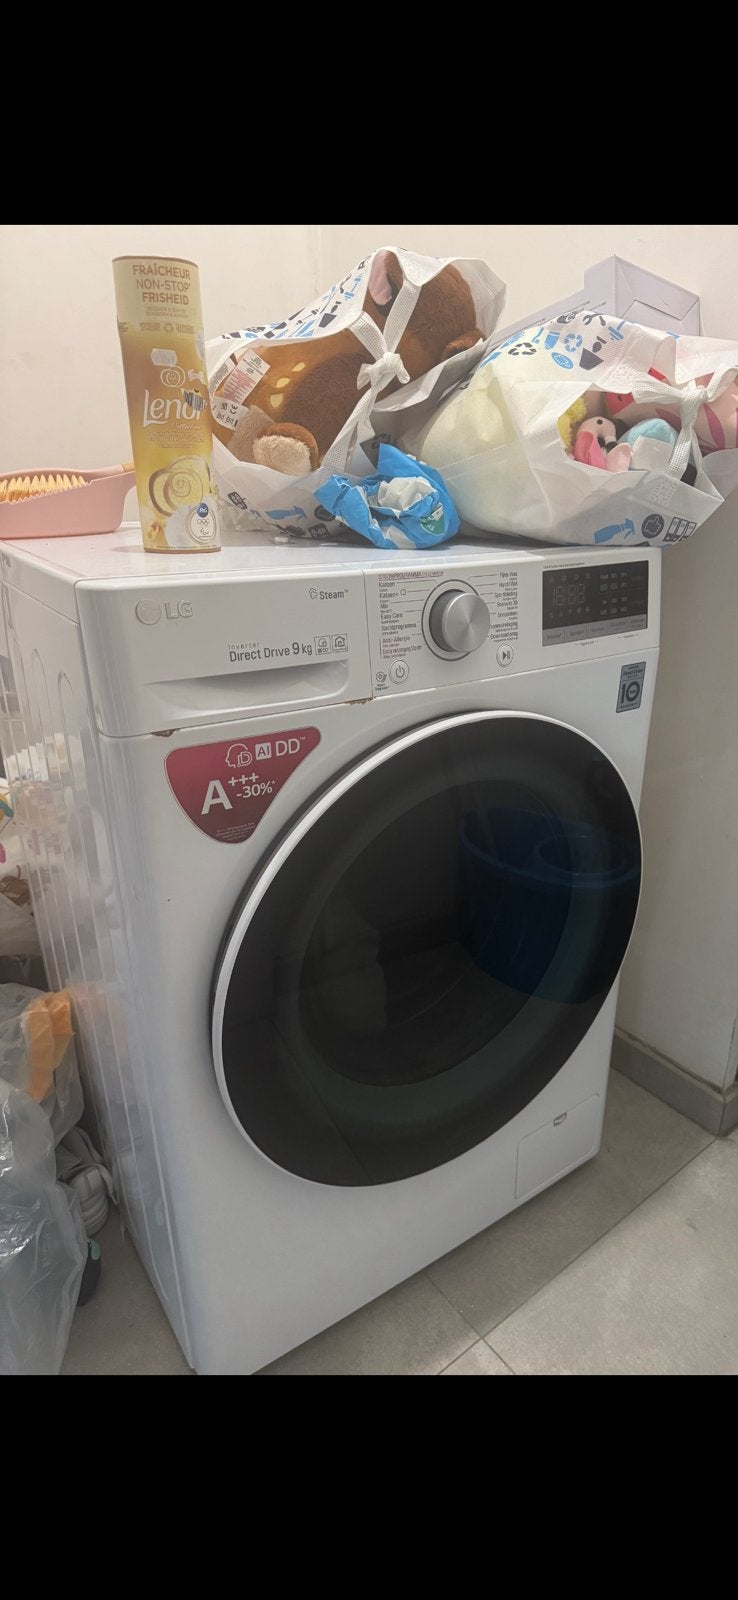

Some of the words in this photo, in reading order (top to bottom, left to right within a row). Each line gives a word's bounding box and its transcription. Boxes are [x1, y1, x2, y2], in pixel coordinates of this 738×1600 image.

[132, 263, 191, 280] FRAÎCHEUR
[142, 292, 189, 306] FRISHEID
[164, 601, 193, 620] LG
[229, 649, 262, 662] Direct
[263, 647, 290, 658] Drive
[292, 642, 300, 655] 9
[301, 643, 313, 656] kg
[620, 681, 641, 704] 10
[257, 745, 271, 758] AI
